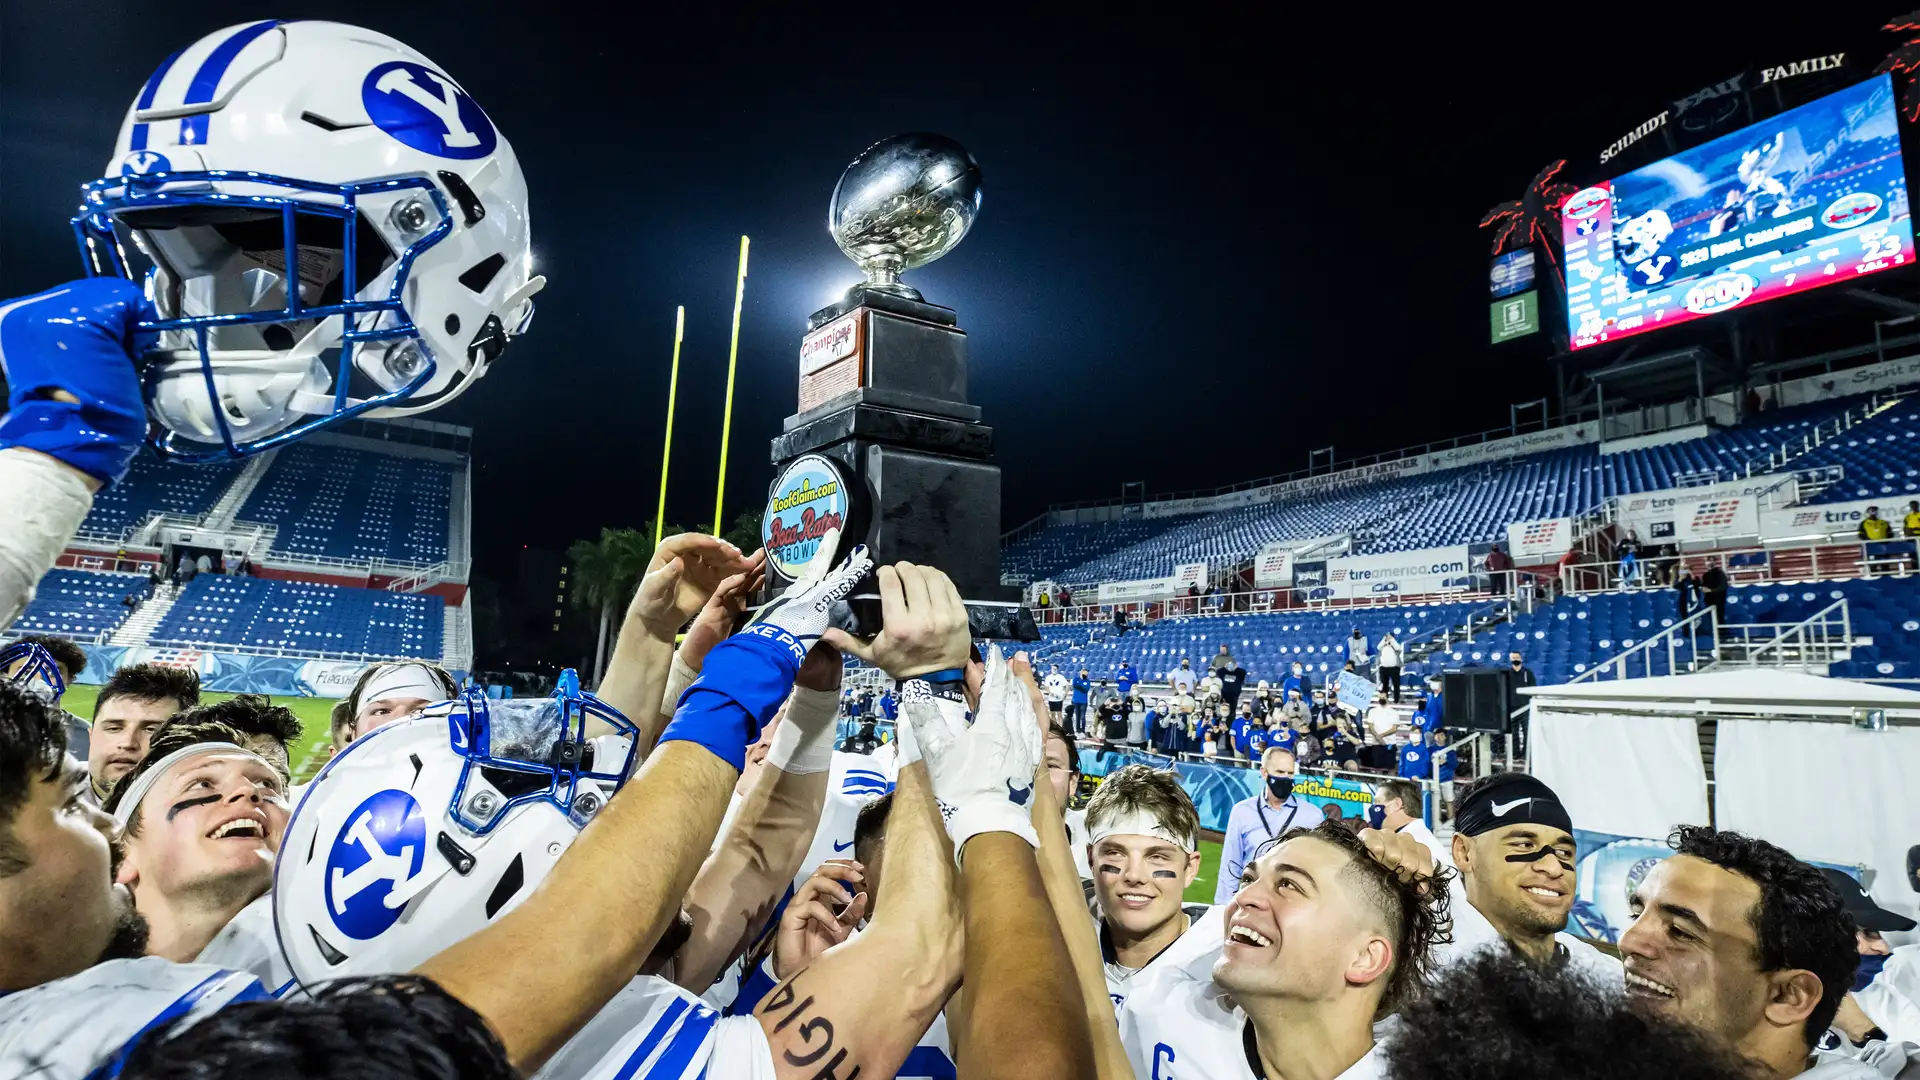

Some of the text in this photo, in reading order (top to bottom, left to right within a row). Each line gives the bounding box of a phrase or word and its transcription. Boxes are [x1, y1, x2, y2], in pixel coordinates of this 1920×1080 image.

[1761, 53, 1846, 83] FAMILY
[1600, 110, 1669, 164] SCHMIDT
[1745, 216, 1814, 248] CHAMPIONS
[1862, 235, 1902, 263] 23
[1686, 273, 1753, 311] 0:00
[802, 324, 852, 357] Champions
[1259, 458, 1419, 497] OFFICIAL CHARITABLE PARTNER
[772, 478, 838, 514] RoofClaim.com
[767, 516, 800, 550] Boca
[786, 542, 815, 562] BOWL
[1349, 560, 1464, 581] tireamerica.com
[814, 563, 872, 613] COUGARS
[1116, 582, 1165, 593] tire.com
[741, 624, 806, 668] IKE PRO
[315, 670, 360, 685] FLAGSHIP
[1291, 778, 1373, 804] ofClaim.com
[1152, 1042, 1175, 1080] C
